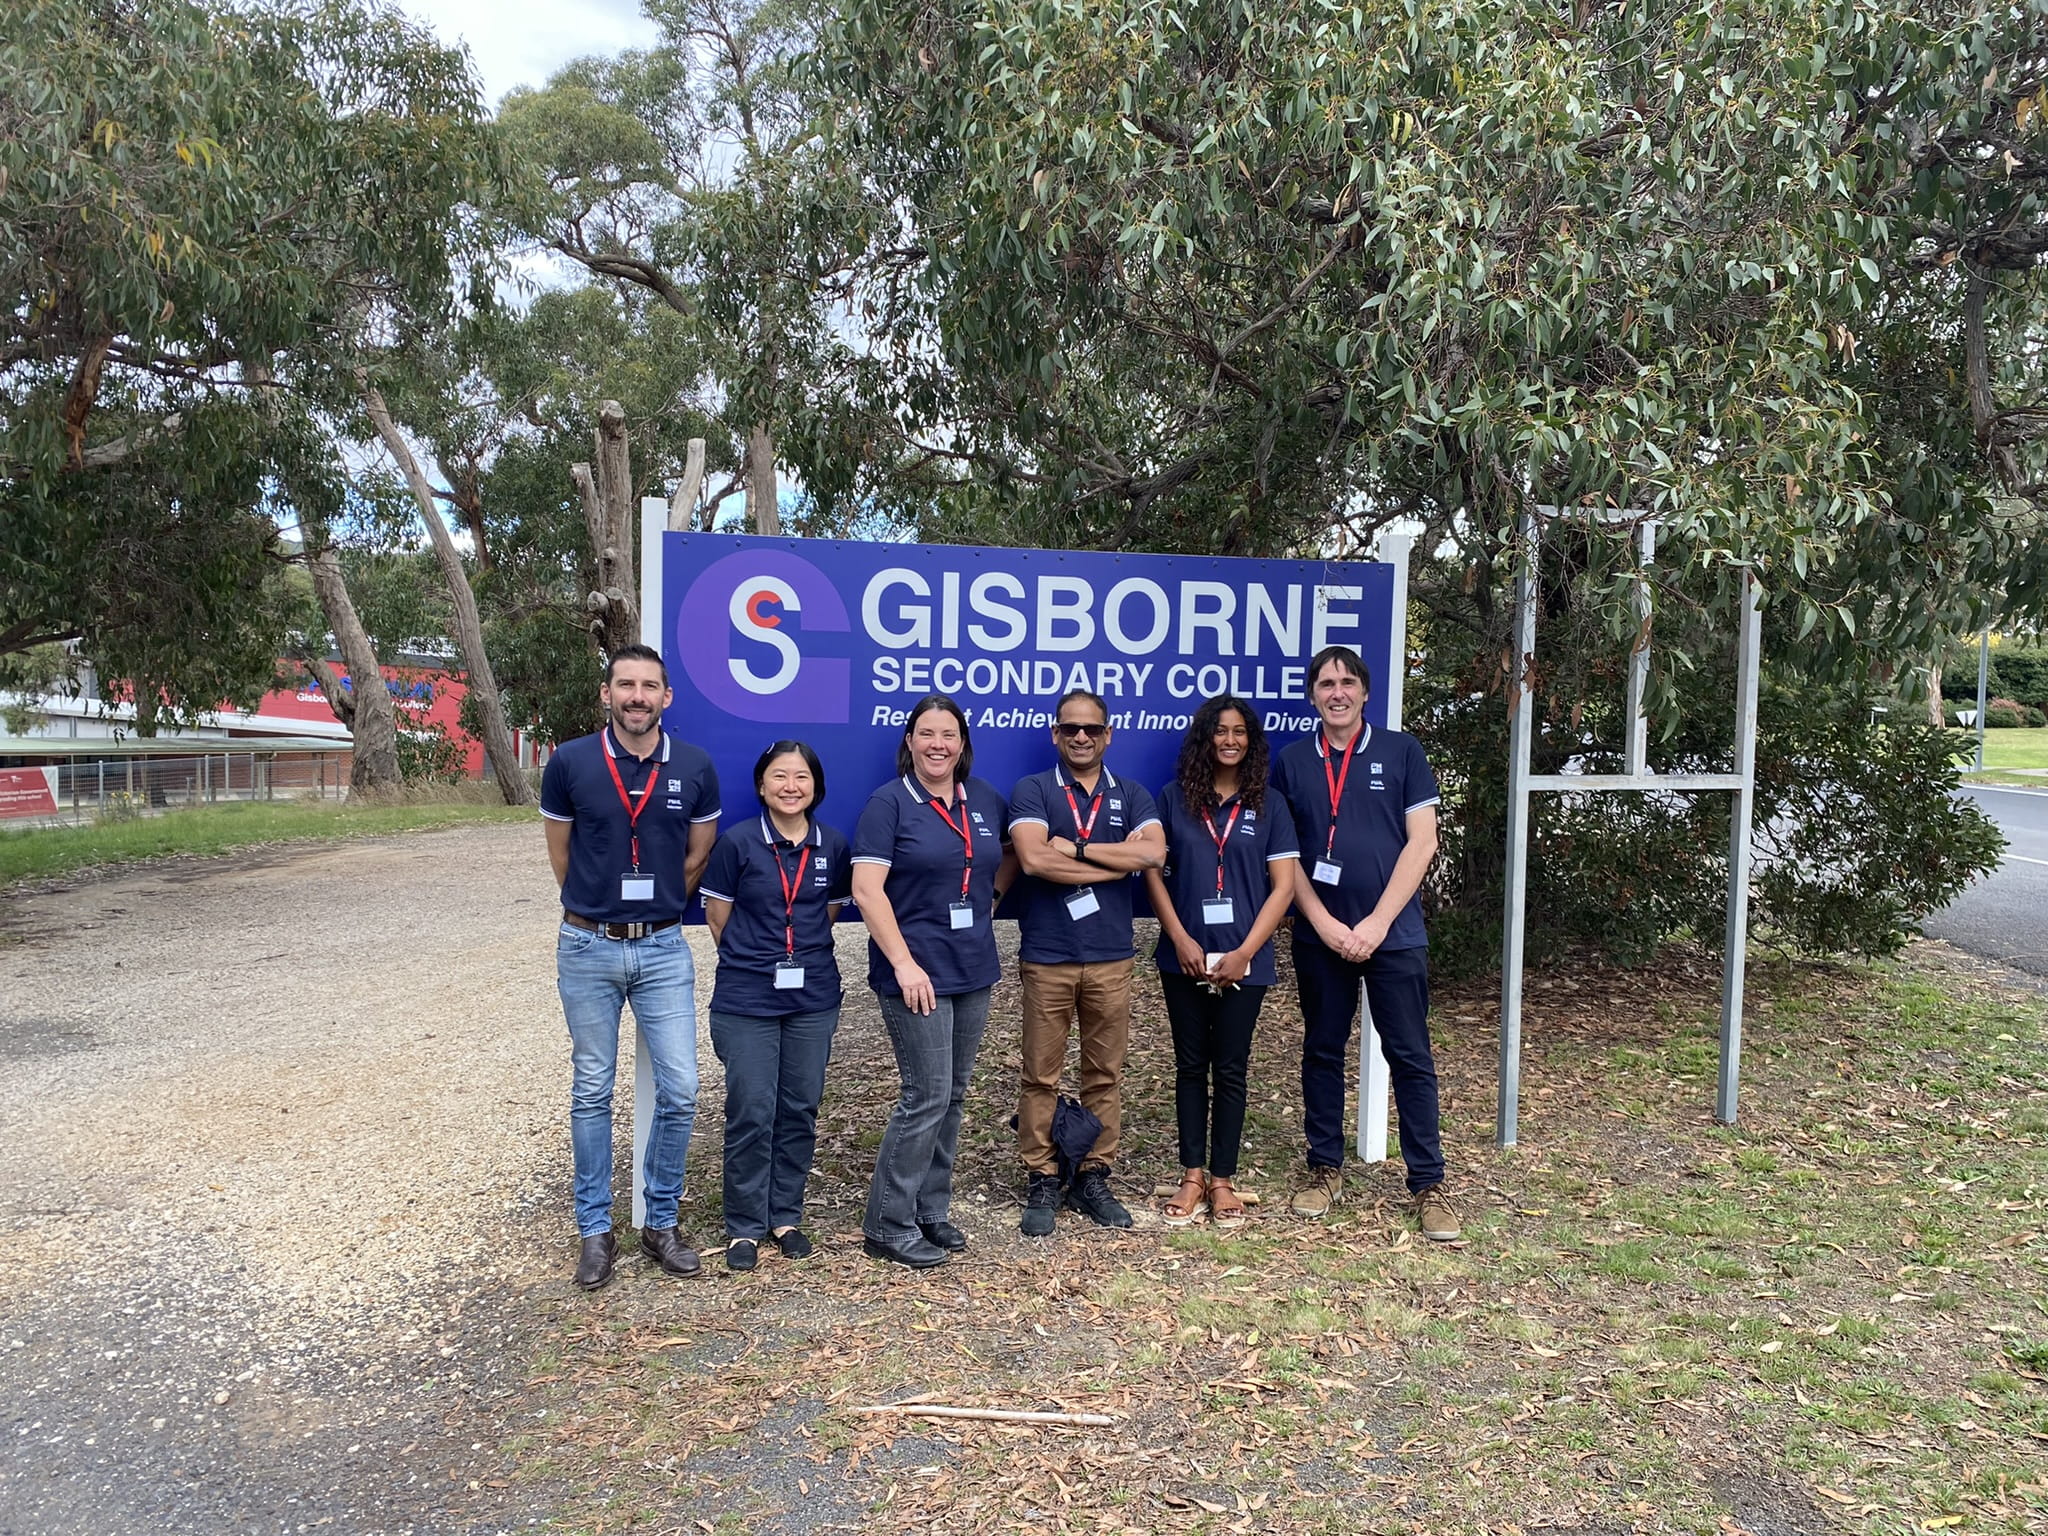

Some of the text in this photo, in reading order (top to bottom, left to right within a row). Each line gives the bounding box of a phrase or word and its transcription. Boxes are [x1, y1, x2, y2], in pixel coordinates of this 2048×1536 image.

[861, 567, 1363, 658] GISBORNE
[872, 656, 1305, 699] SECONDARY COLLE
[1263, 711, 1322, 732] Diver
